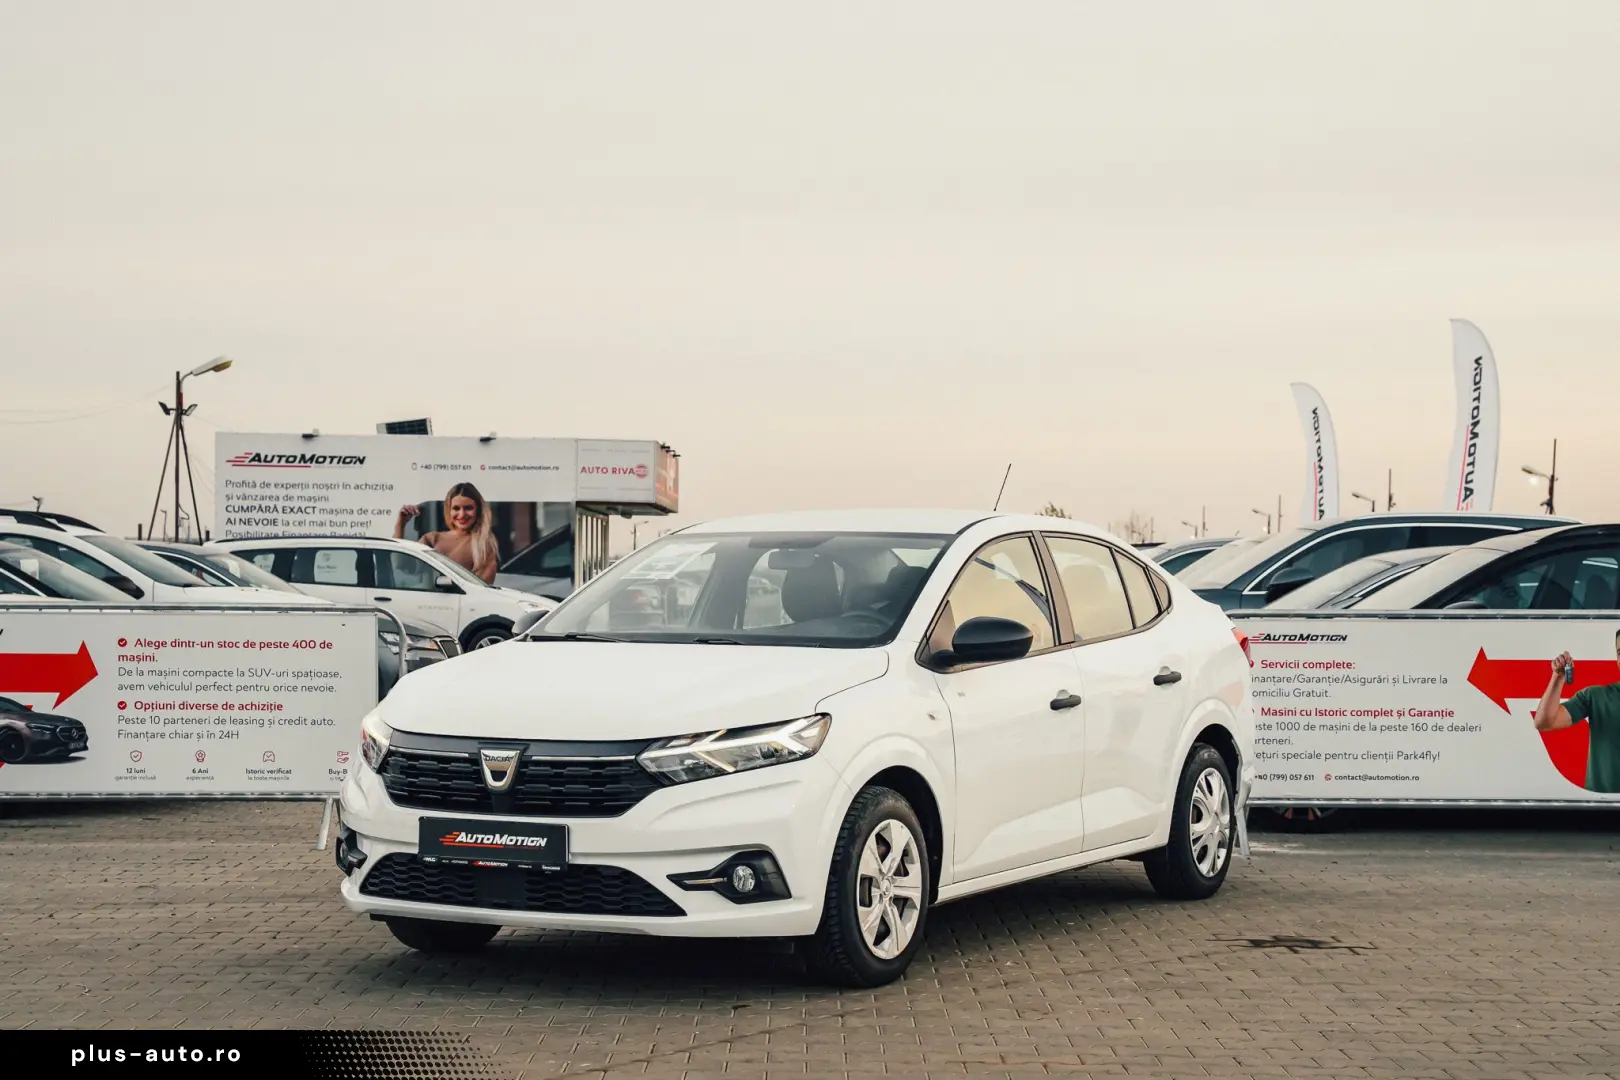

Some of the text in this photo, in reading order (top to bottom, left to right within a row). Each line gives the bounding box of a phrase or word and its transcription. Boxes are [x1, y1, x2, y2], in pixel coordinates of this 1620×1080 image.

[580, 466, 608, 474] AUTO
[225, 480, 257, 489] Profită
[260, 480, 271, 489] de
[274, 481, 309, 490] experții
[312, 482, 340, 491] noștri
[353, 482, 394, 492] achiziția
[225, 493, 233, 501] și
[236, 492, 279, 501] vânzarea
[225, 504, 279, 514] CUMPĂRĂ
[282, 506, 317, 514] EXACT
[319, 507, 354, 516] mașina
[356, 507, 369, 515] de
[239, 518, 278, 526] NEVOIE
[281, 518, 289, 527] la
[292, 518, 306, 527] cel
[309, 520, 327, 528] mai
[329, 520, 348, 528] bun
[134, 638, 333, 651] Alege dintr-un stoc de peste 400 de
[118, 652, 159, 664] mașini.
[1260, 659, 1356, 671] Servicii complete:
[118, 667, 343, 681] De la mașini compacte la SUV-uri spațioase,
[1251, 673, 1448, 687] inanțare/Garanție/Asigurări și Livrare la
[117, 681, 338, 694] avem vehiculul perfect pentru orice nevoie.
[1251, 688, 1332, 698] omiciliu Gratuit.
[134, 701, 284, 714] Opțiuni diverse de achiziție
[1299, 709, 1312, 717] cu
[1314, 707, 1347, 717] Istoric
[1349, 708, 1394, 719] complet
[1396, 708, 1405, 719] și
[1407, 708, 1455, 720] Garanție
[117, 714, 337, 729] Peste 10 parteneri de leasing și credit auto.
[1275, 721, 1301, 731] 1000
[1302, 722, 1317, 731] de
[1318, 723, 1351, 734] mașini
[1352, 722, 1366, 732] de
[1368, 722, 1377, 732] la
[1380, 723, 1408, 734] peste
[1410, 723, 1428, 732] 160
[1430, 723, 1445, 732] de
[1446, 723, 1482, 733] dealeri
[117, 729, 240, 743] Finanțare chiar și în 24H
[1254, 736, 1294, 746] rteneri.
[1281, 750, 1322, 761] speciale
[1324, 752, 1358, 762] pentru
[1360, 751, 1394, 763] clienții
[1396, 751, 1440, 763] Park4fly!
[328, 768, 348, 776] Buy-B
[1334, 774, 1420, 782] contact@automotion.ro
